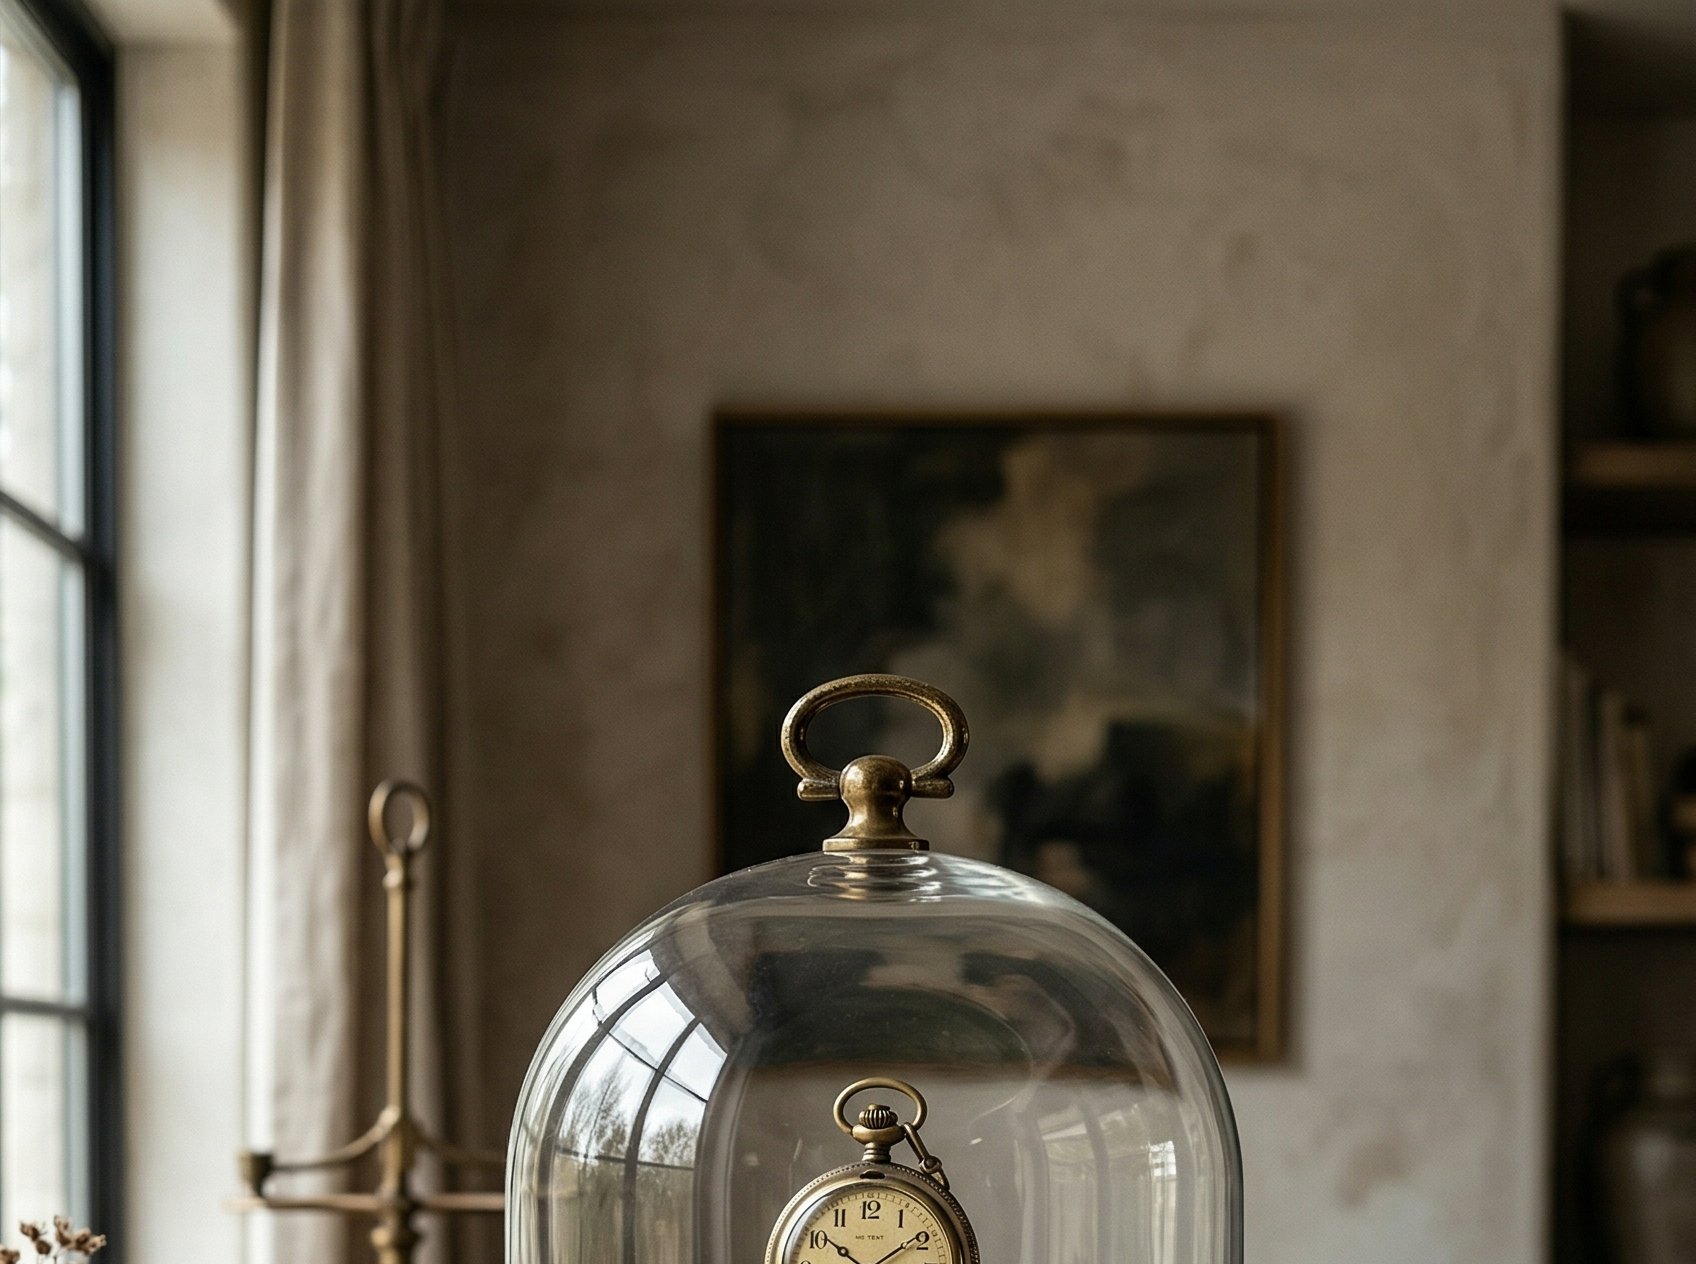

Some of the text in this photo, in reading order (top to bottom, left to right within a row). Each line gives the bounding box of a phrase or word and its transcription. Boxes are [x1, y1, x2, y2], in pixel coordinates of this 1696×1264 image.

[833, 1208, 846, 1228] 11
[861, 1200, 881, 1220] 12
[897, 1209, 904, 1228] 1
[809, 1230, 828, 1249] 10
[915, 1230, 930, 1250] 2
